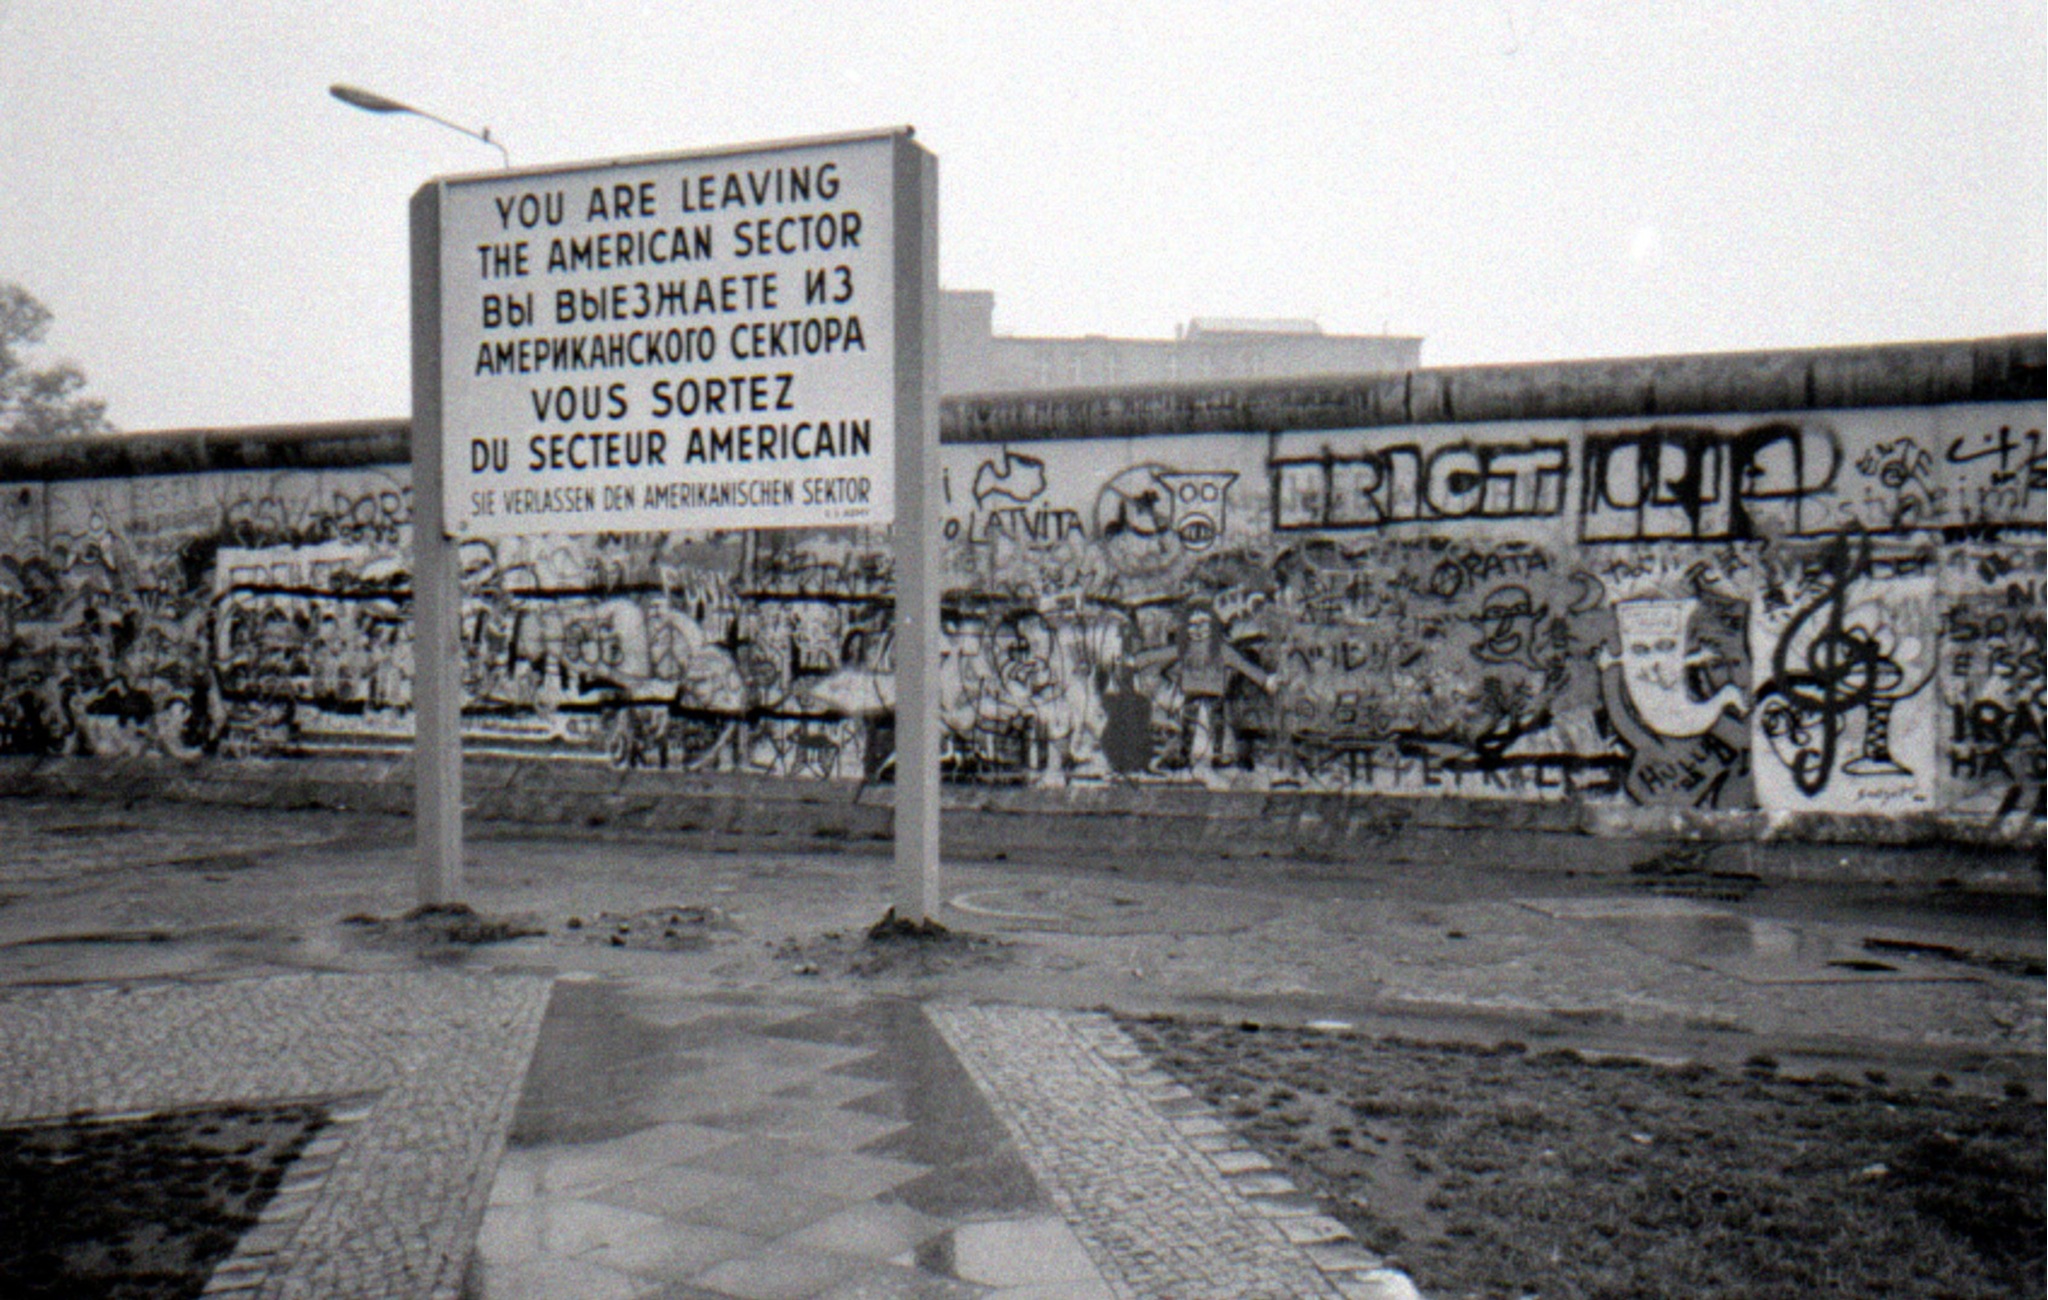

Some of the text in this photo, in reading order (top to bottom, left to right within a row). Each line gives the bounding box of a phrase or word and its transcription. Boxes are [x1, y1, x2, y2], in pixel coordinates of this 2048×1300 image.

[495, 162, 841, 230] YOU ARE LEAVING
[477, 210, 863, 279] THE AMERICAN SECTOR
[482, 265, 855, 329] ВЫ ВЫЕЗЖАЕТЕ ИЗ
[475, 315, 867, 376] АМЕРИКАНСКОГО СЕКТОРА
[531, 372, 795, 423] VOUS SORTEZ
[471, 418, 872, 474] DU SECTEUR AMERICAIN
[471, 476, 872, 517] SIE VERLASSEN DEN AMERIKANISCHEN SEKTOR
